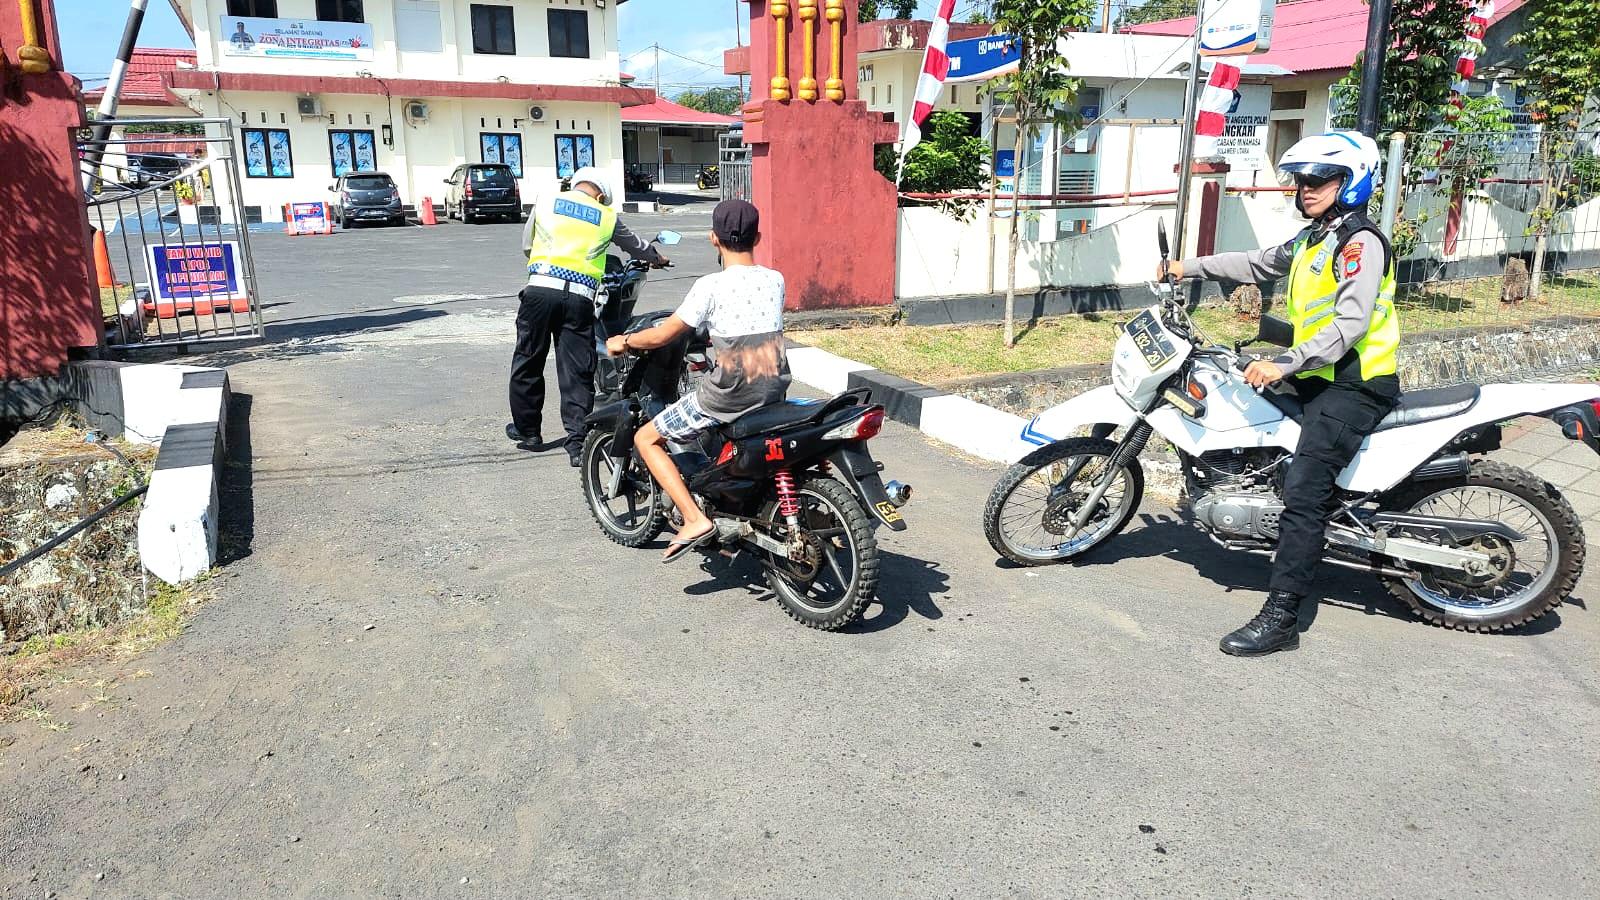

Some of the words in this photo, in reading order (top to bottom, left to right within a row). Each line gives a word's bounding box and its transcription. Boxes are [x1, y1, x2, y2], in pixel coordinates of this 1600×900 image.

[259, 35, 285, 44] ZONA
[286, 36, 340, 47] INTEGRITAS
[988, 41, 1004, 50] BANK
[1231, 115, 1253, 124] ANGGOTA
[1254, 115, 1268, 124] POLRI
[1217, 138, 1236, 146] CABANG
[1238, 138, 1261, 146] MINAHASA
[555, 200, 601, 224] POLISI
